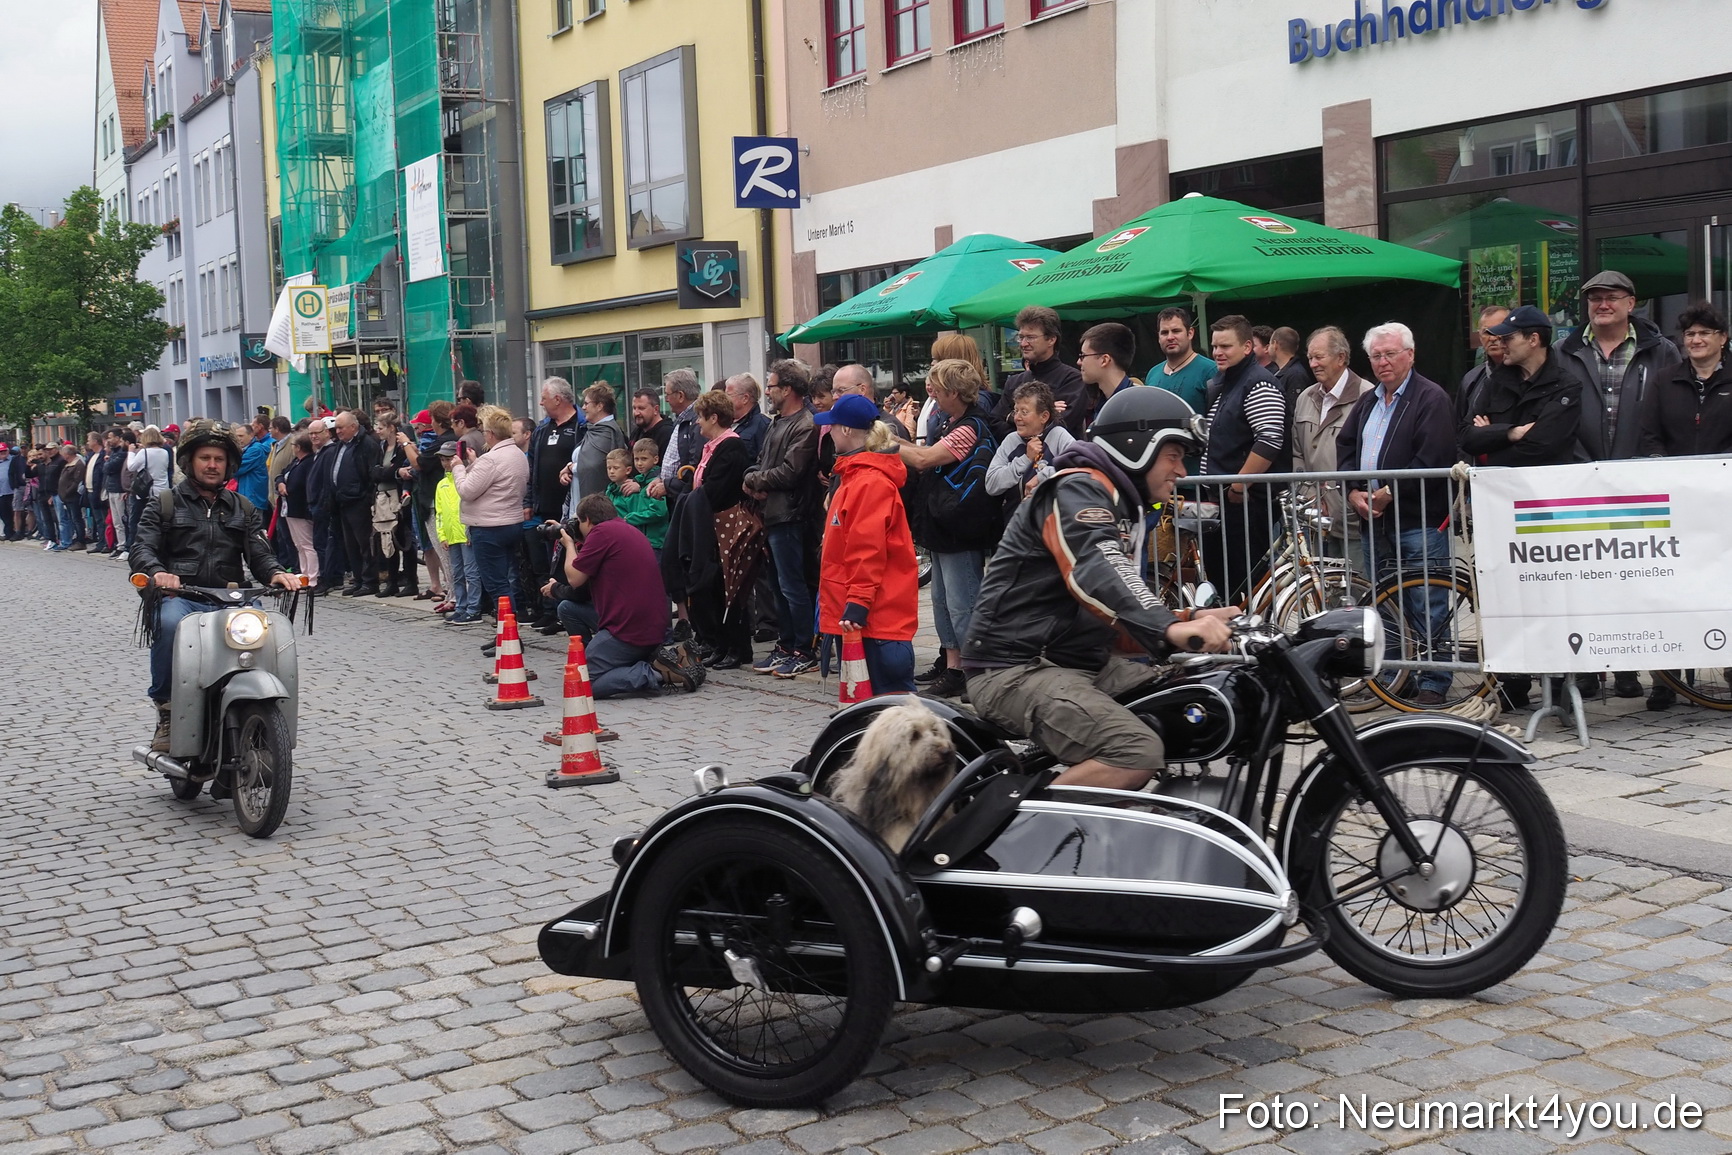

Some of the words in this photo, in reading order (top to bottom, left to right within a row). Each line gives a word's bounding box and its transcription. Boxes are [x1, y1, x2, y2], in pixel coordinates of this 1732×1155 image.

[1288, 0, 1604, 64] Buchhan
[807, 227, 828, 242] Unterer
[828, 223, 846, 238] Markt
[847, 221, 854, 233] 15
[1257, 236, 1342, 245] Neumarkter
[1252, 244, 1375, 257] Lammsbräu
[1054, 251, 1132, 271] Neumarkter
[1026, 259, 1131, 288] Lammsbräu
[1474, 265, 1497, 274] Wald-
[1497, 264, 1513, 272] und
[1475, 283, 1513, 293] Kochbuch
[1509, 535, 1681, 564] NeuerMarkt
[1519, 570, 1573, 582] einkaufen
[1580, 569, 1612, 580] leben
[1619, 567, 1674, 581] genießen
[1588, 630, 1656, 642] Dammstraße
[1658, 630, 1664, 640] 1
[1589, 643, 1641, 655] Neumarkt
[1643, 644, 1650, 653] i.
[1651, 643, 1661, 653] d.
[1663, 642, 1685, 653] OPf.
